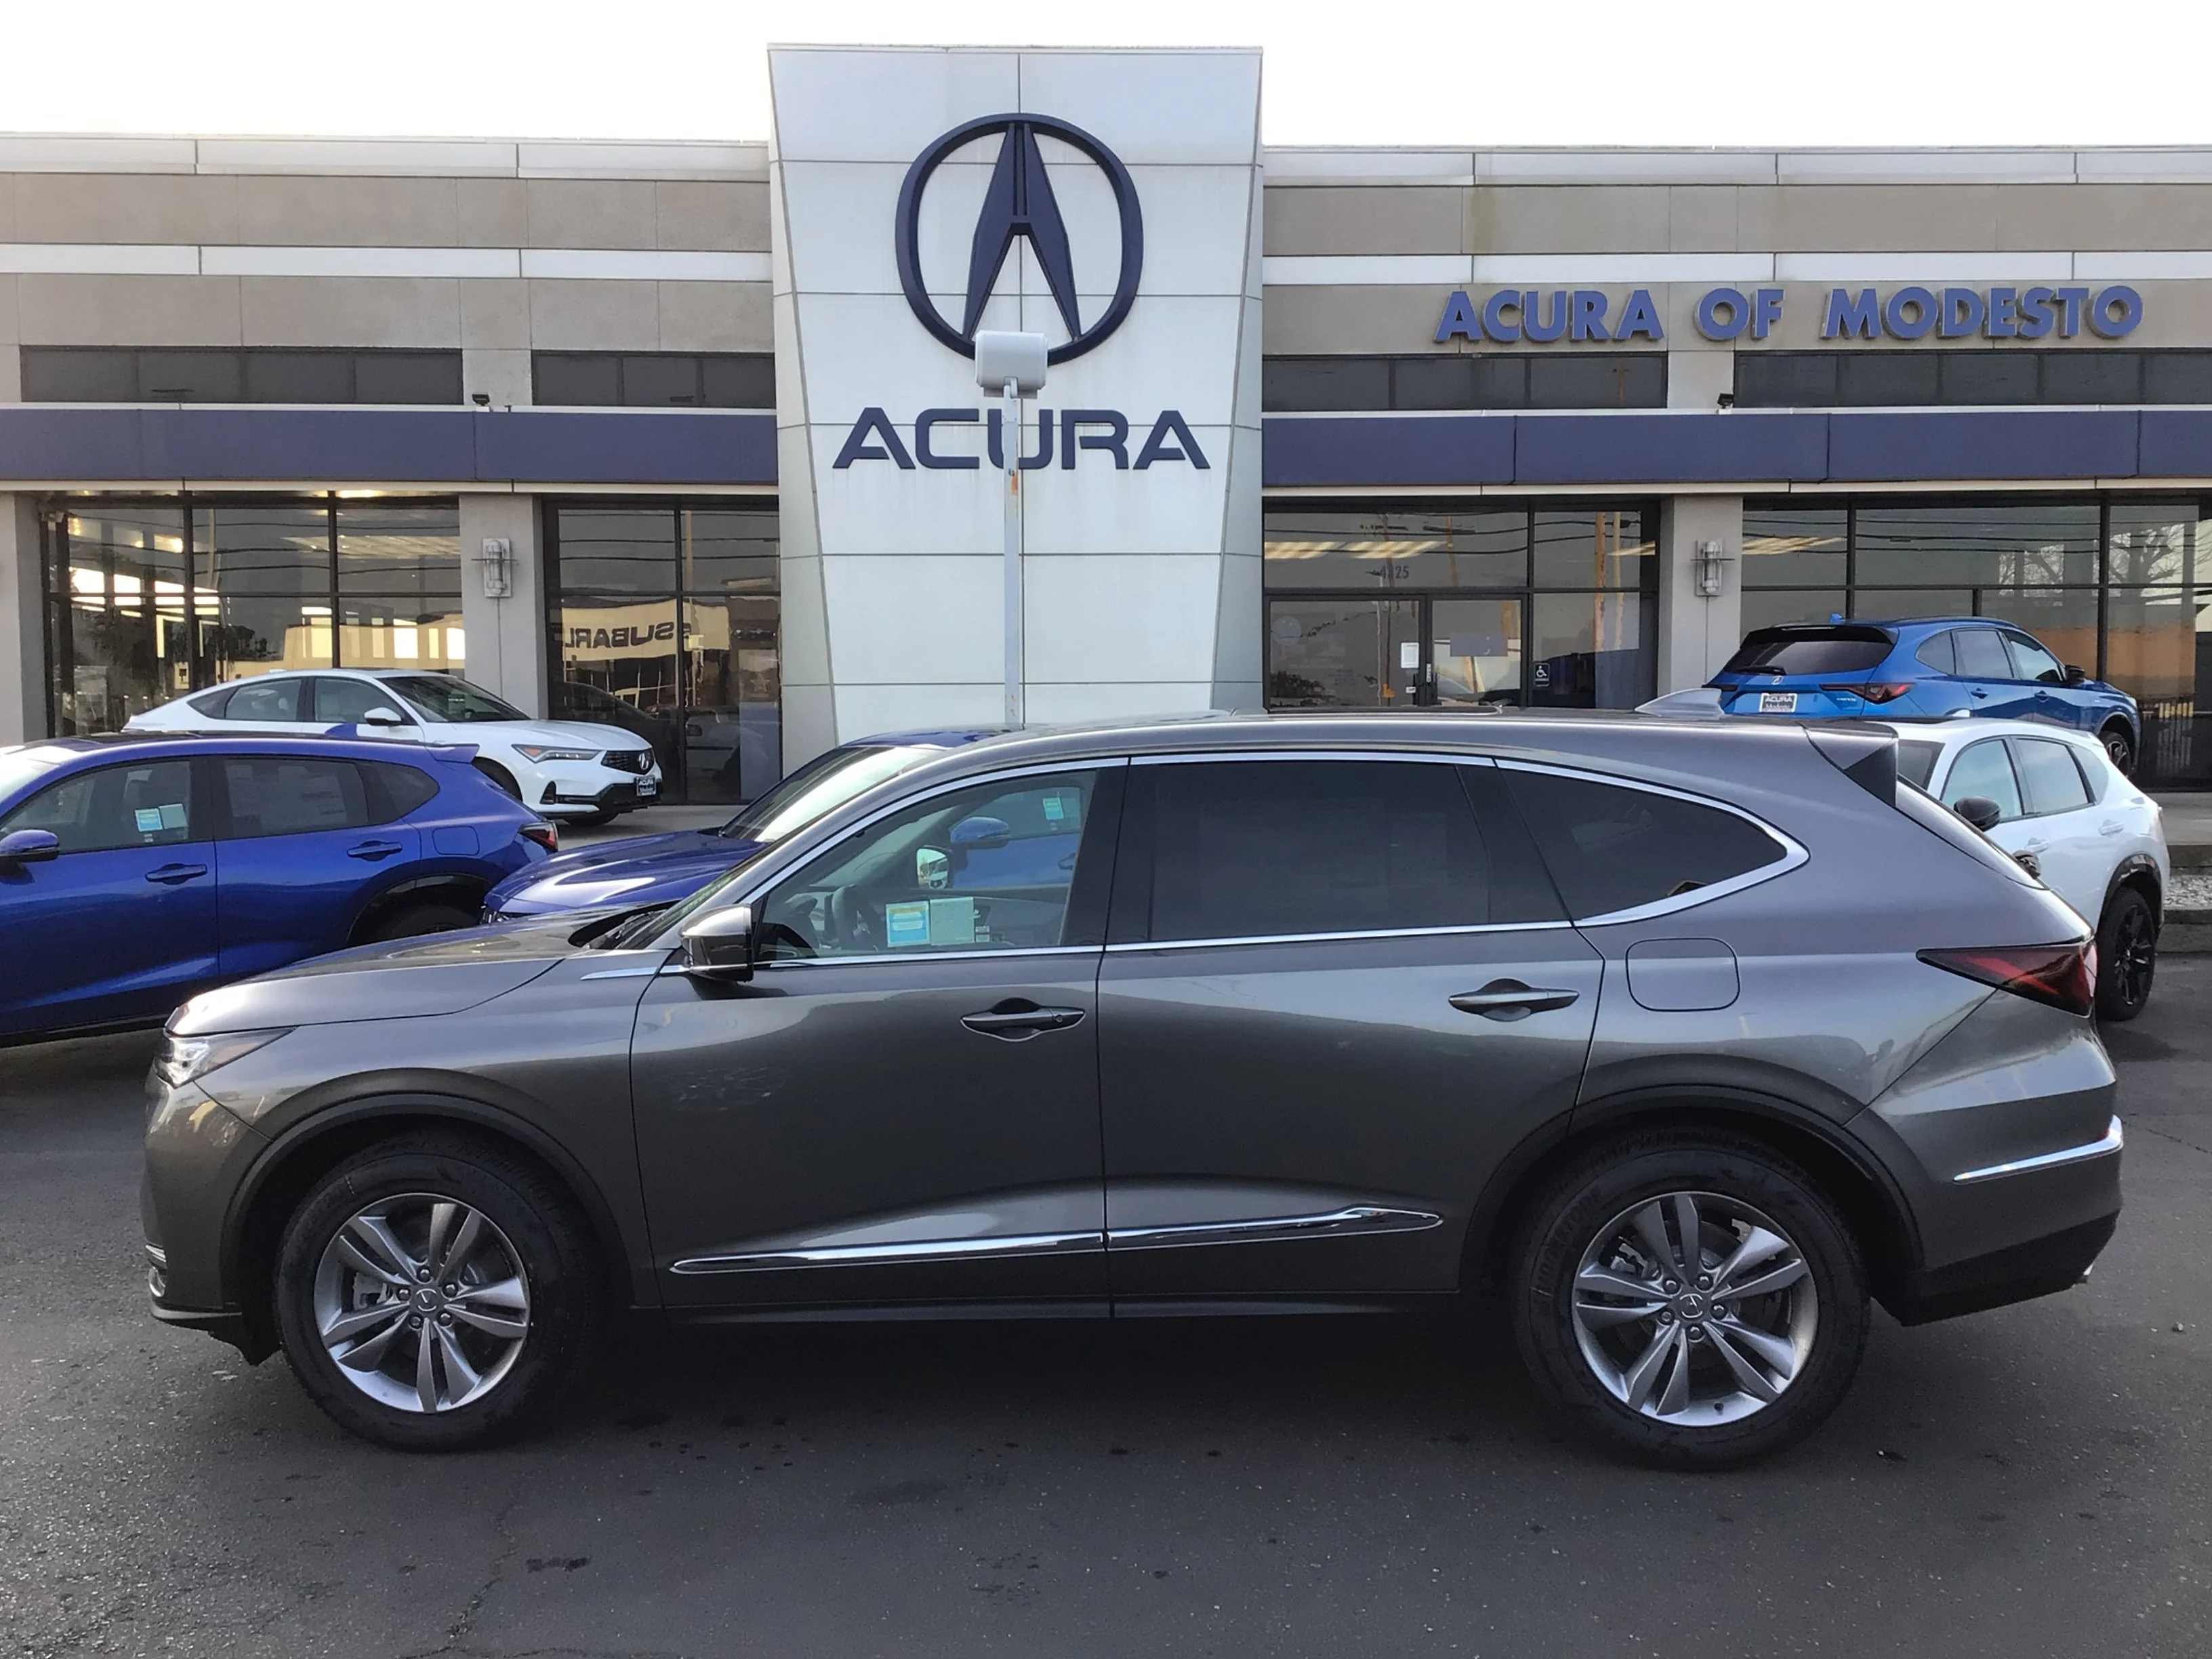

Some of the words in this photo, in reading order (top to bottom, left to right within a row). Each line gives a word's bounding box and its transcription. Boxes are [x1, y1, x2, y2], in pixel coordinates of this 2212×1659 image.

[1433, 289, 1664, 342] ACURA
[1696, 287, 1785, 341] OF
[1820, 285, 2144, 339] MODESTO
[832, 407, 1211, 470] ACURA
